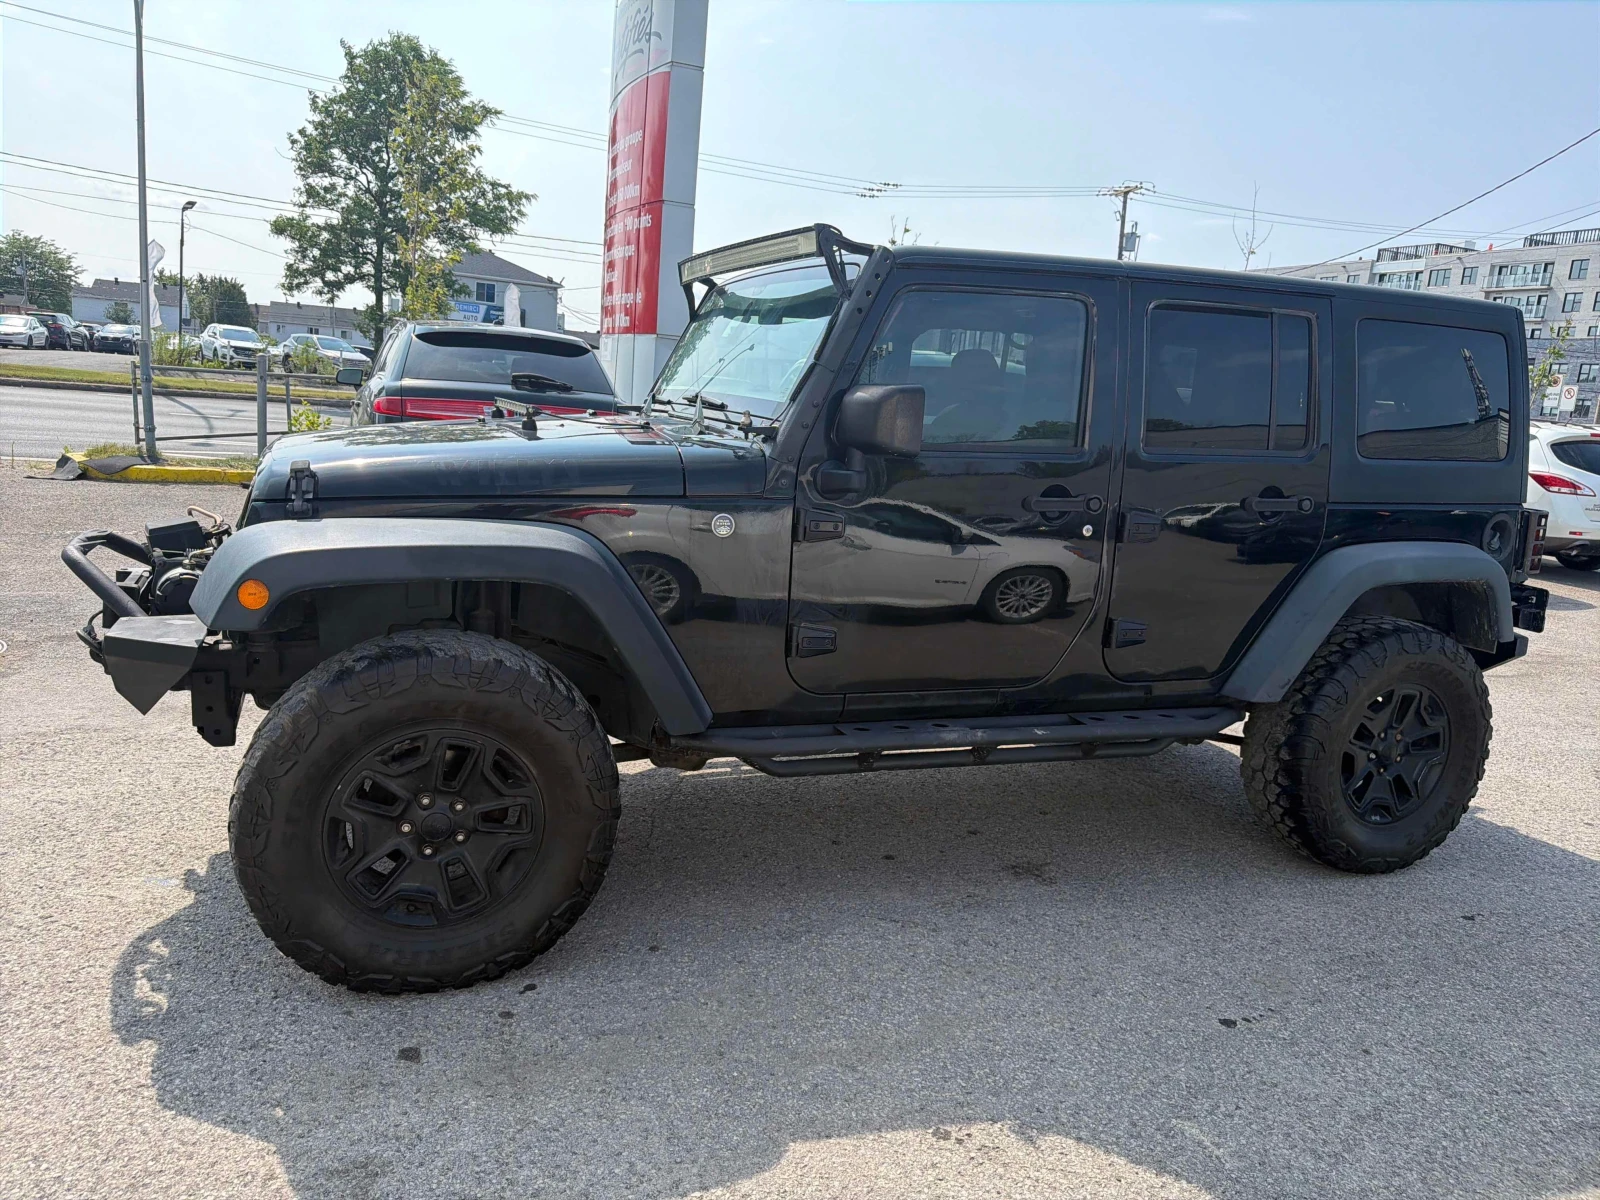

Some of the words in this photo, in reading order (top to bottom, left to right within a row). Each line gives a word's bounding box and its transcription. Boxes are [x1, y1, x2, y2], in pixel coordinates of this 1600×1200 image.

[624, 129, 642, 151] groupe
[634, 211, 652, 233] points
[463, 314, 478, 322] AUTO
